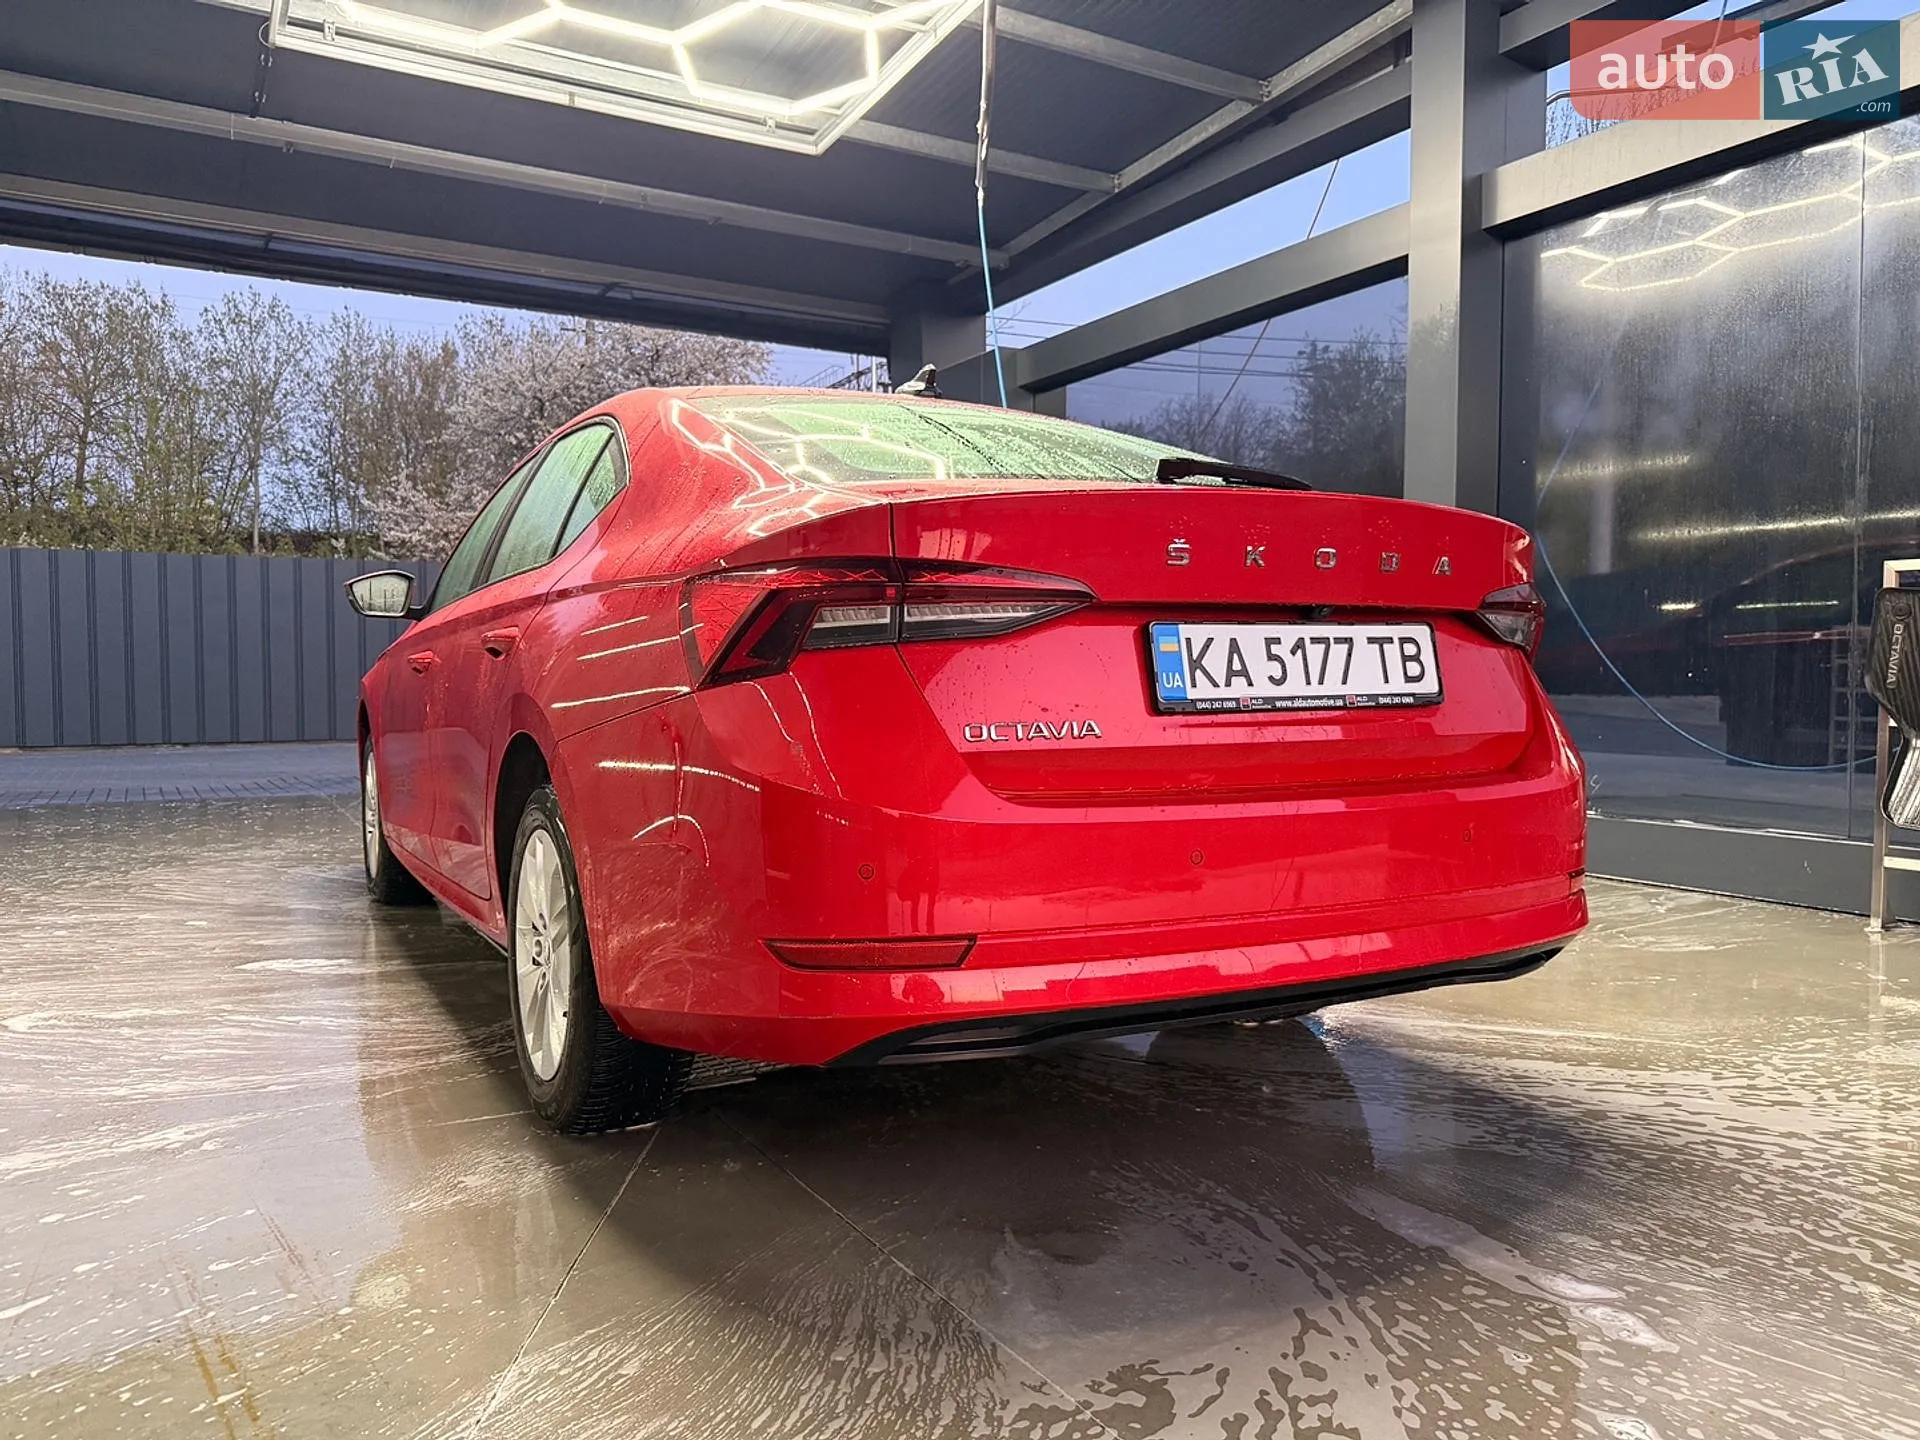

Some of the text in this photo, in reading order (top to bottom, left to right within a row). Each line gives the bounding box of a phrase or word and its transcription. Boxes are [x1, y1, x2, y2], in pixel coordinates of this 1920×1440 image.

[1166, 538, 1452, 575] ŠKODA
[1185, 637, 1425, 688] KA 5177 TB
[1886, 623, 1904, 685] OCTAVIA
[1163, 672, 1183, 688] UA
[964, 720, 1102, 741] OCTAVIA
